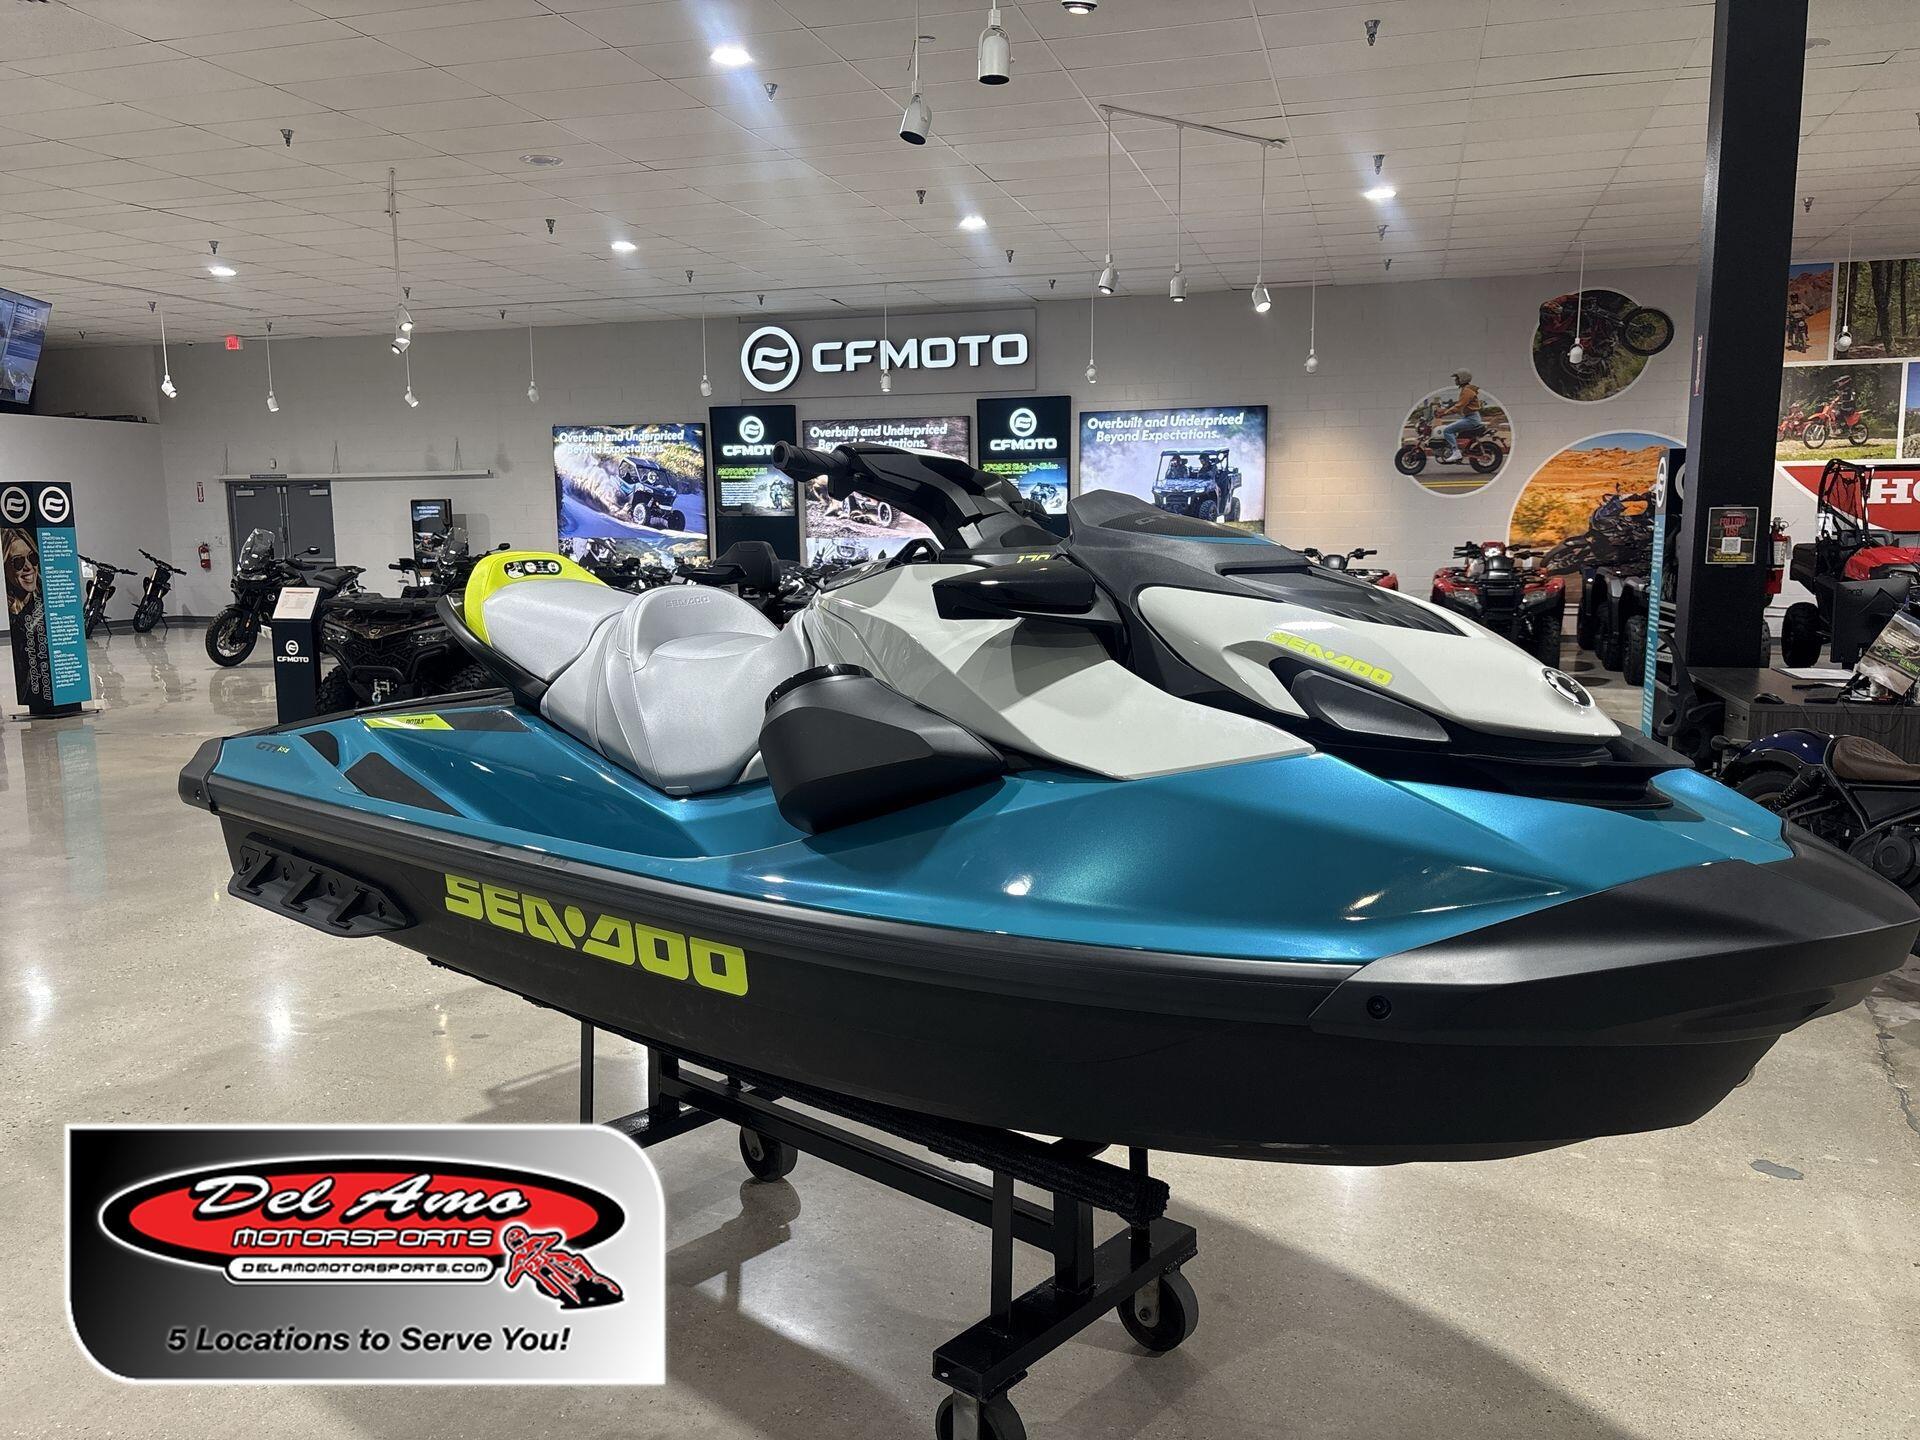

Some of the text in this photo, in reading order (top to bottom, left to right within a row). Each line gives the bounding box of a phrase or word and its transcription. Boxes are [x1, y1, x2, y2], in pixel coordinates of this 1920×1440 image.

[811, 333, 1028, 373] CFMOTO
[1087, 412, 1244, 430] Overbuilt and Underpriced
[559, 430, 684, 445] Overbuilt and Underpriced
[810, 423, 948, 439] Overbuilt and Underpriced
[1096, 429, 1220, 445] Beyond Expectations.
[567, 443, 602, 456] Beyond
[722, 444, 775, 457] CFMOT
[990, 438, 1058, 451] CFMOTO
[1867, 478, 1920, 504] H
[24, 614, 42, 695] experience
[41, 661, 52, 700] more
